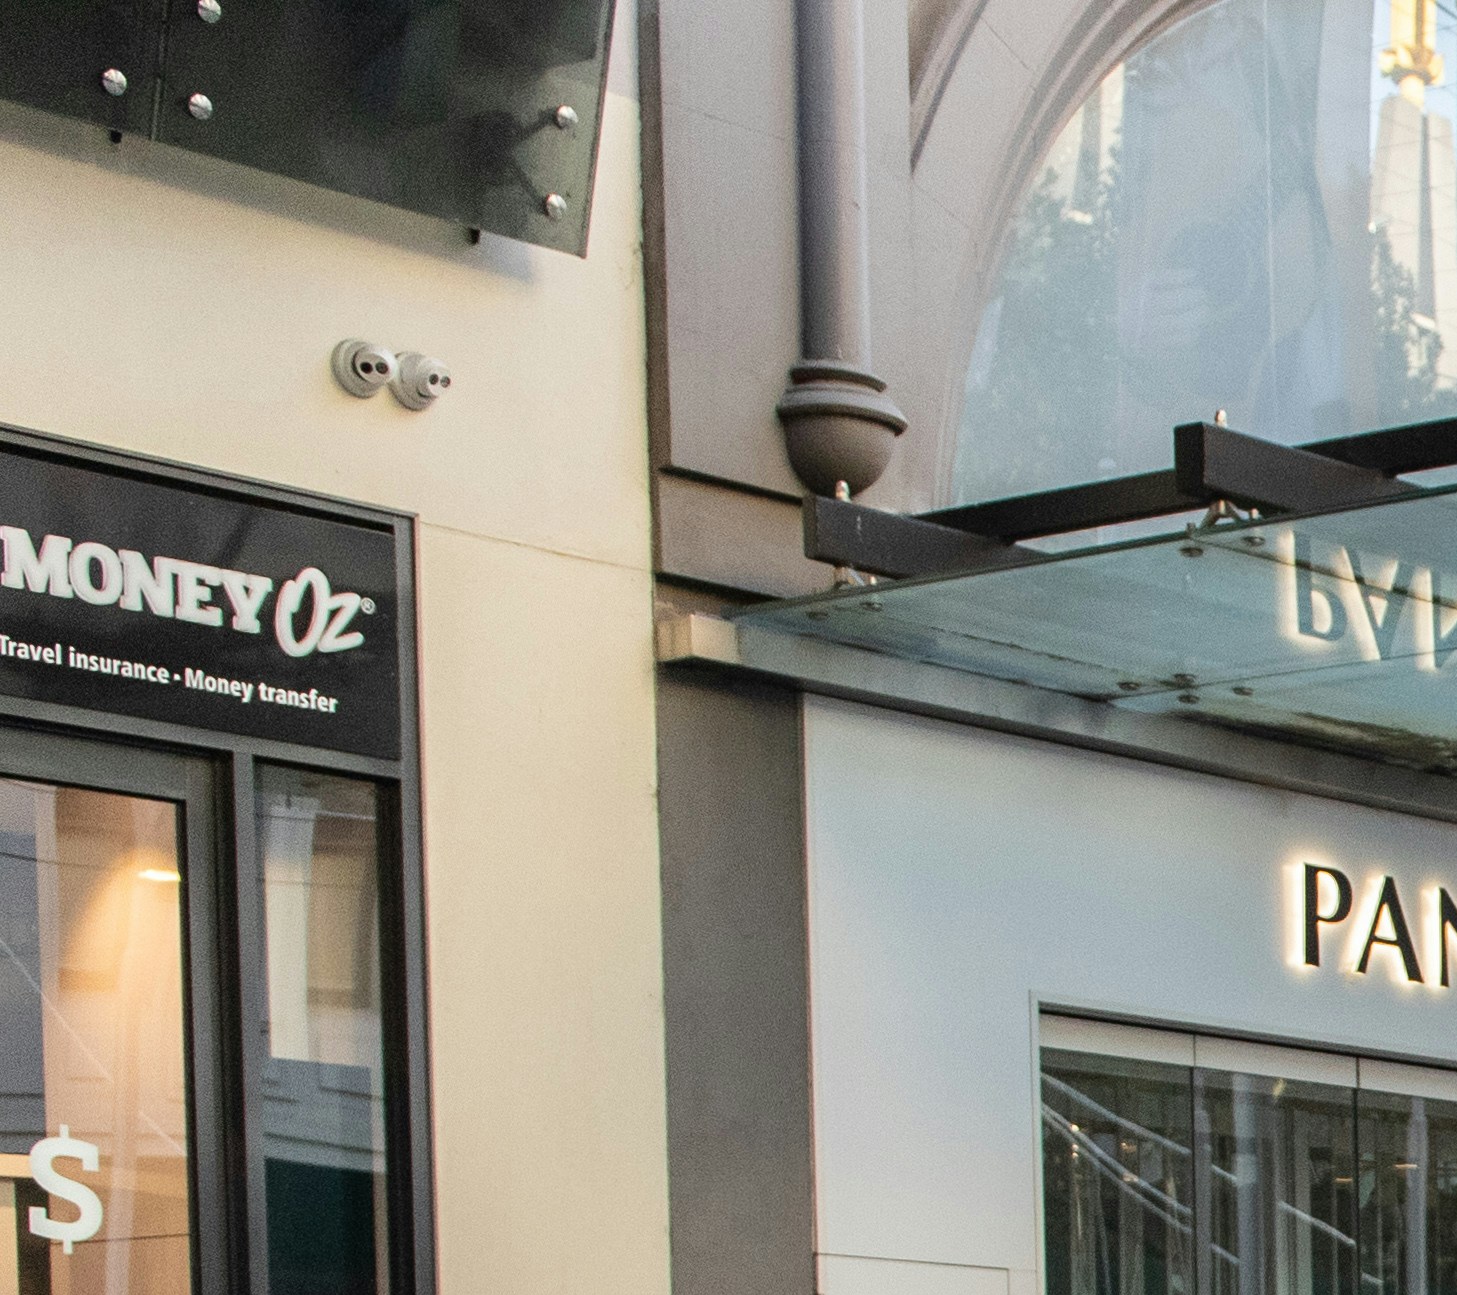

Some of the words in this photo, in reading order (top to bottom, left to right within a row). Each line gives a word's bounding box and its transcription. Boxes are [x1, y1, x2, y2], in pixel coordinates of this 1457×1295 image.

[1, 525, 273, 634] MONEY
[0, 635, 63, 667] Travel
[68, 646, 170, 685] insurance
[184, 667, 254, 704] Money
[258, 681, 339, 714] transfer
[28, 1124, 104, 1254] $
